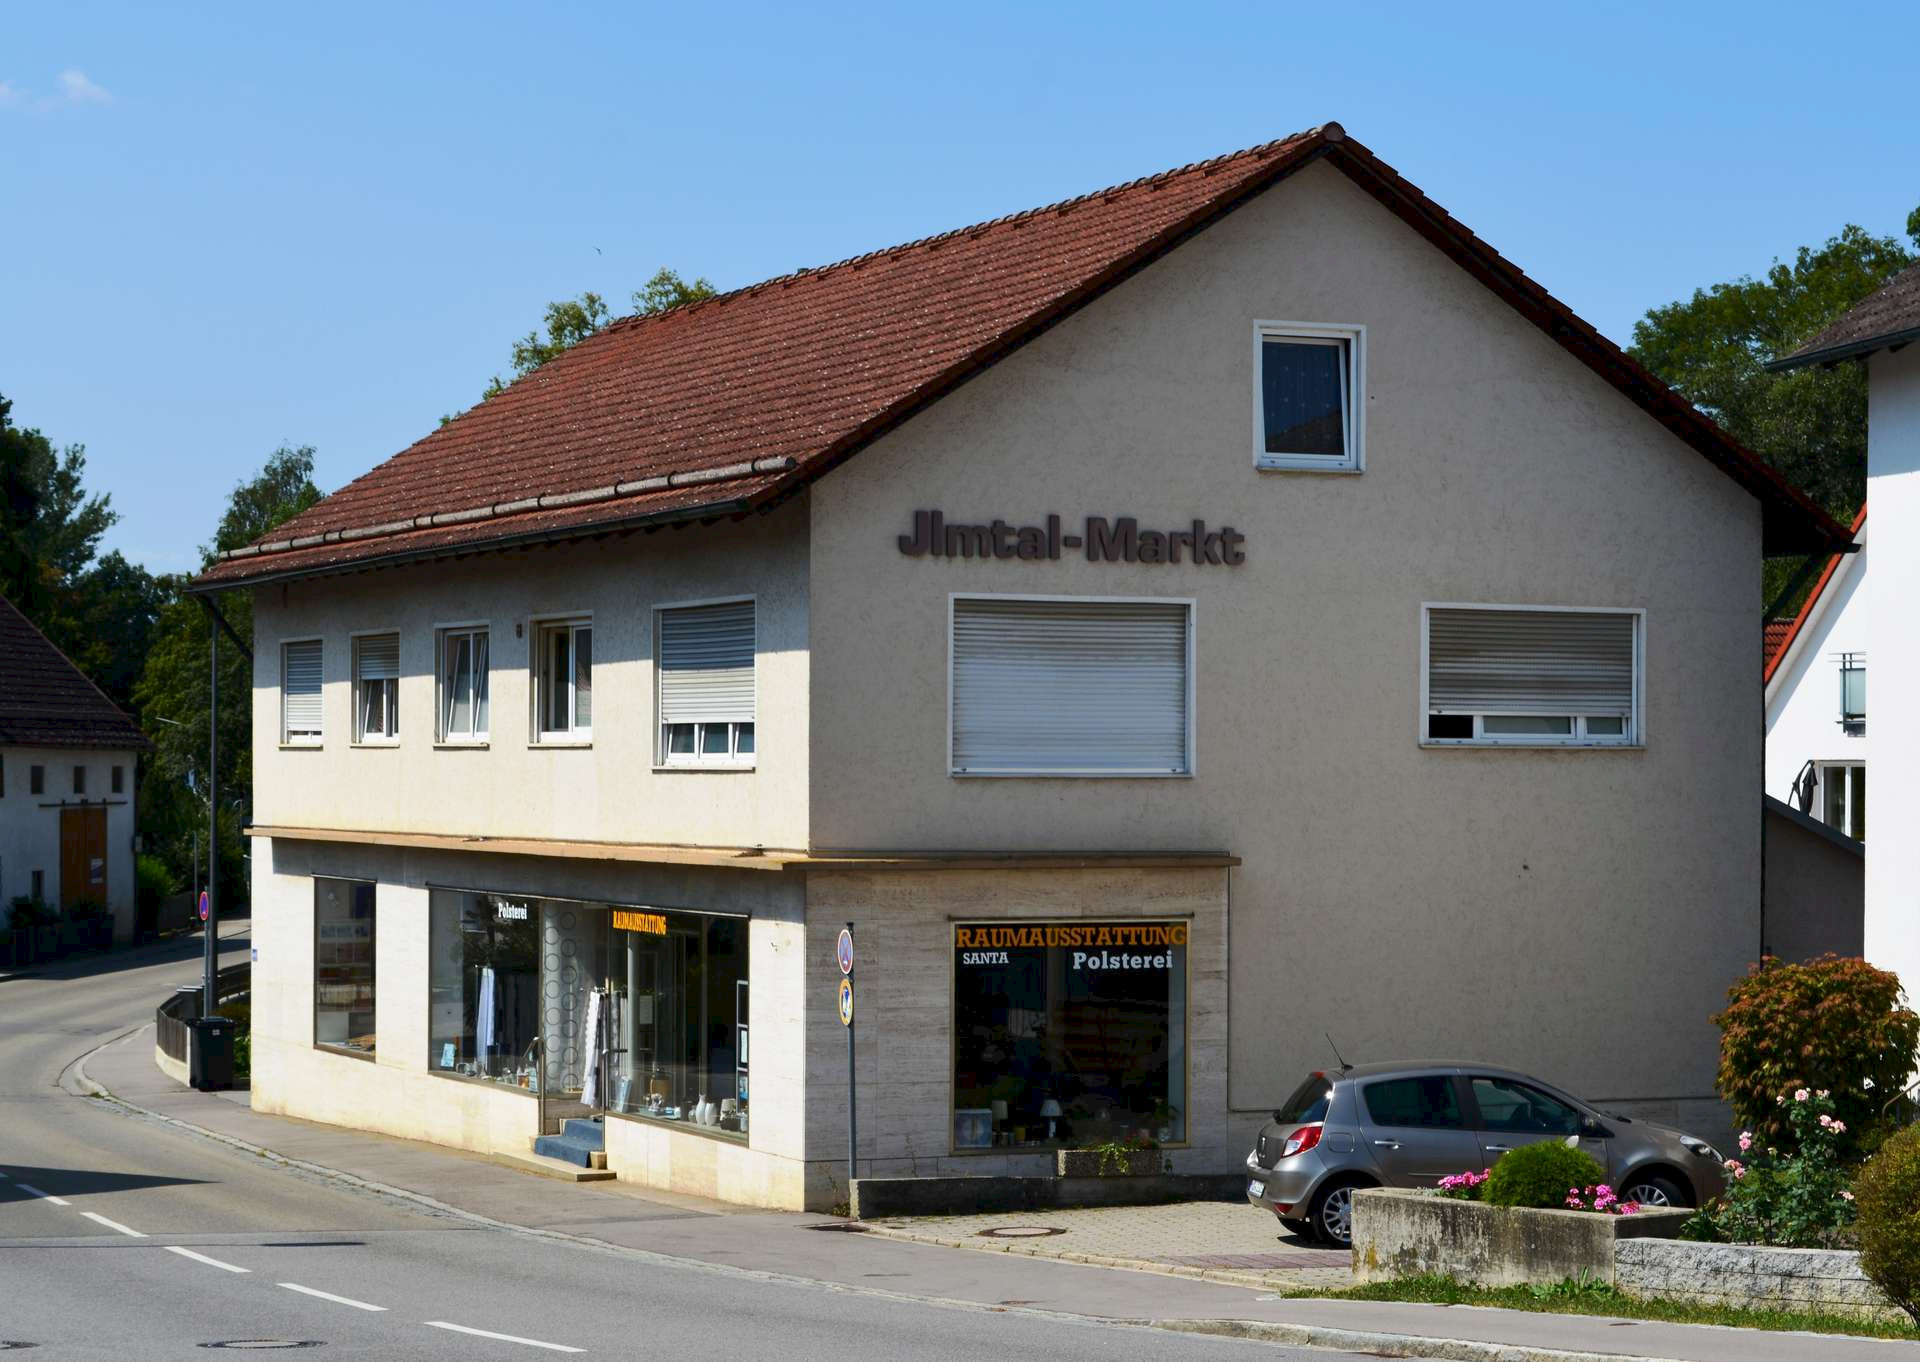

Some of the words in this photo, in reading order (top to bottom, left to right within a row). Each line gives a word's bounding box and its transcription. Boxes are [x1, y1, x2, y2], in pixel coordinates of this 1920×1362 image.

[498, 902, 528, 920] Polsterei
[956, 926, 1186, 948] RAUMAUSSTATTUNG
[963, 952, 1010, 965] SANTA
[1072, 950, 1173, 970] Polsterei
